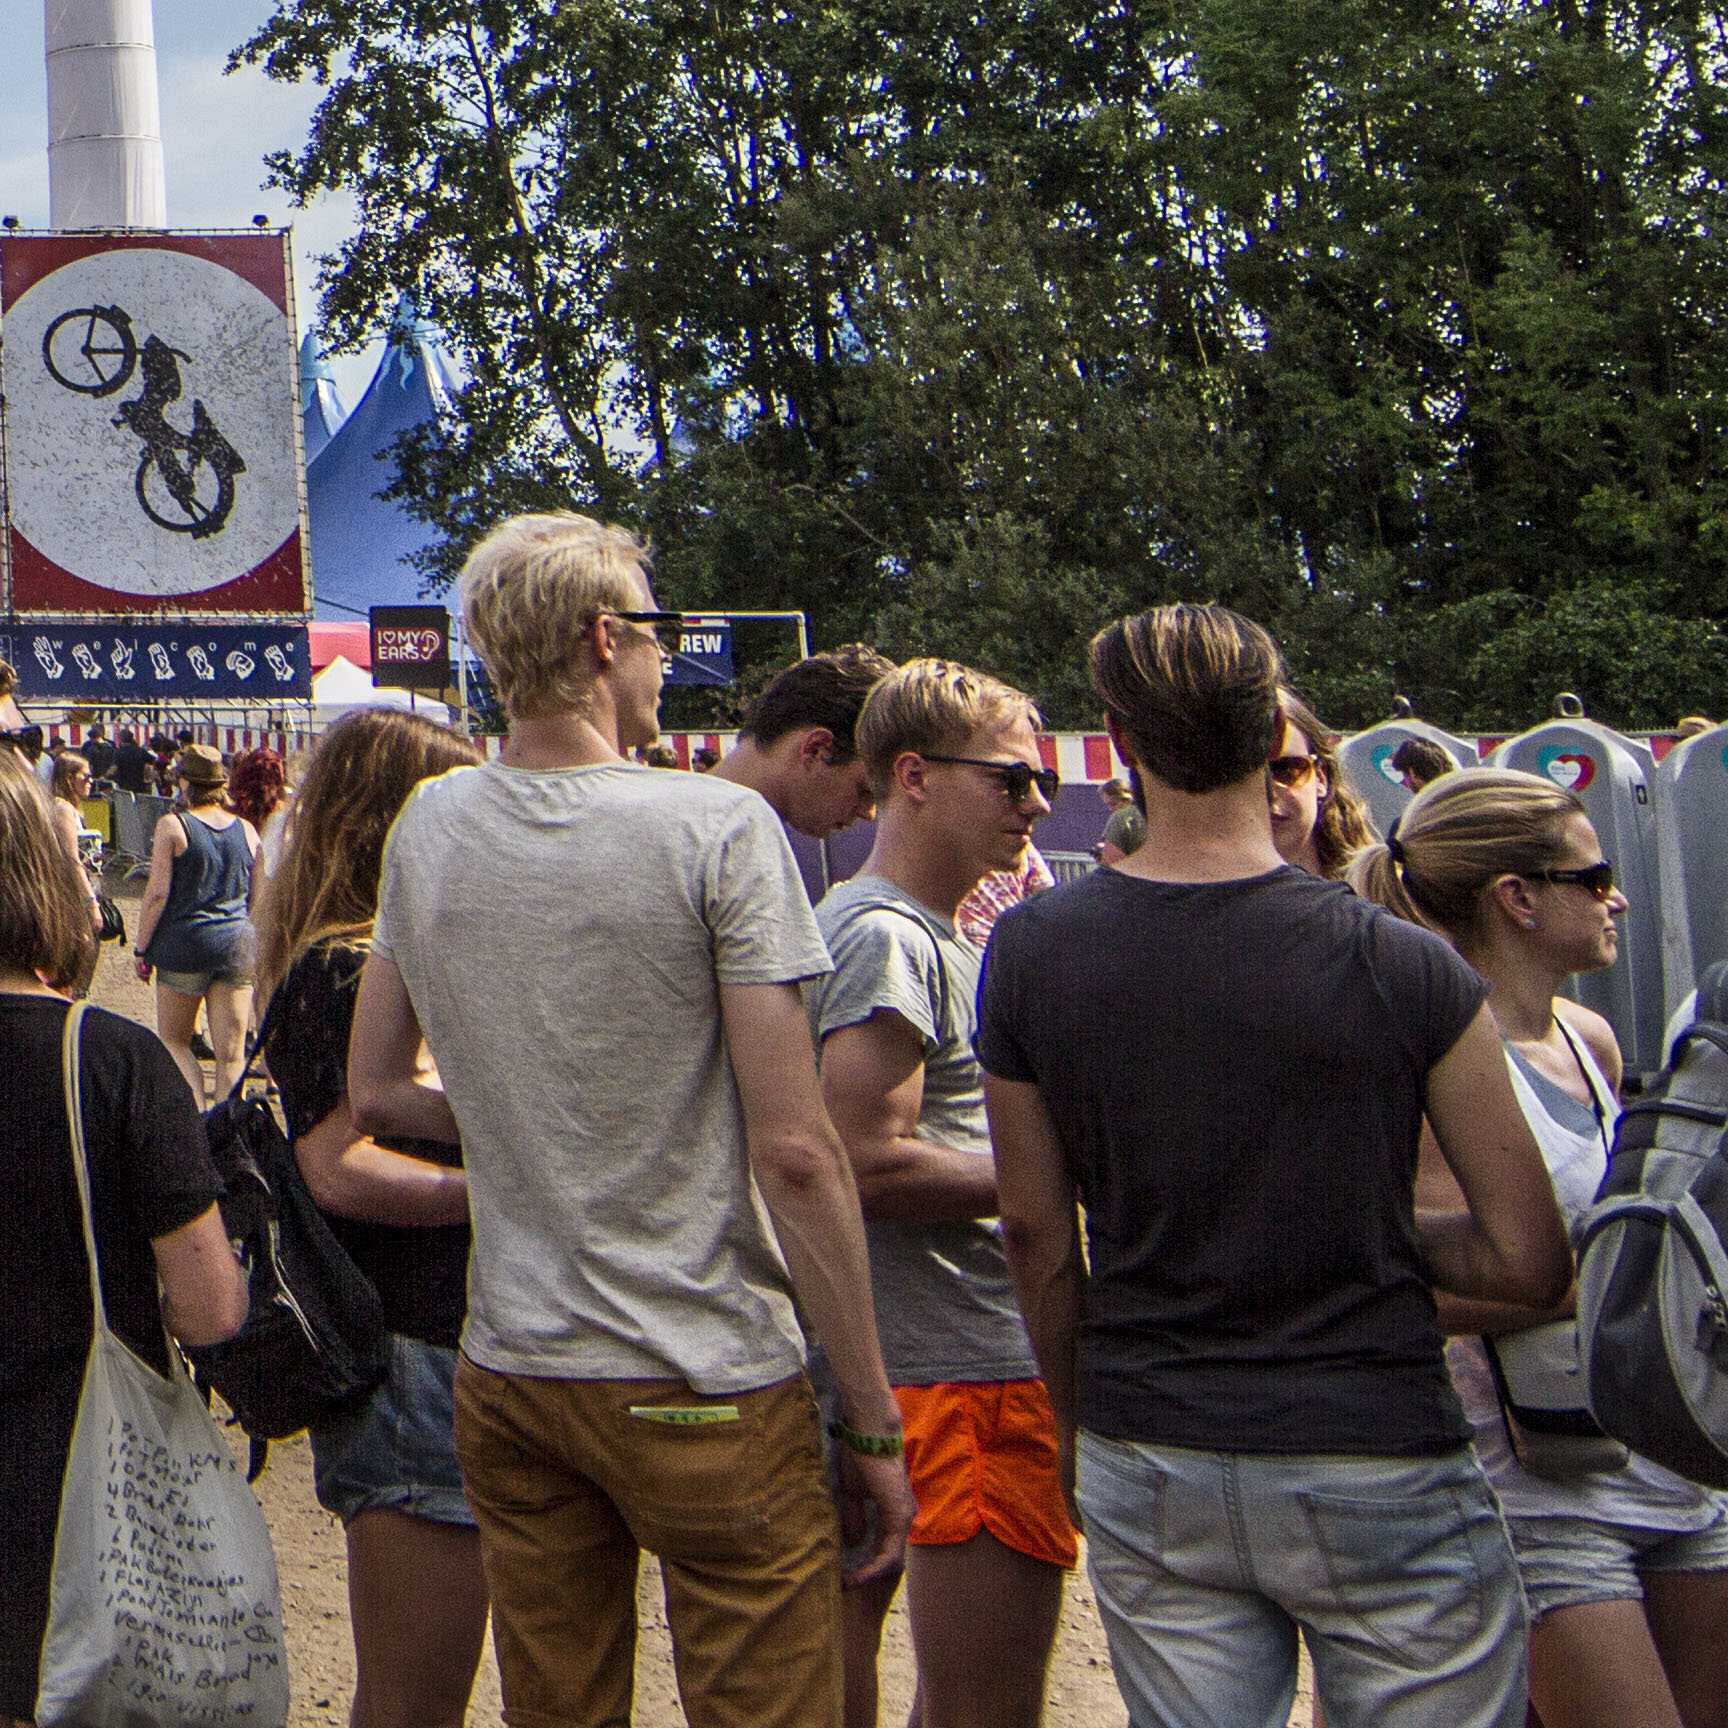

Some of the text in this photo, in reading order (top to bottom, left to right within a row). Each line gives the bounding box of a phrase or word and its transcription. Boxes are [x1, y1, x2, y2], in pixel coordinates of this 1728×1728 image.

[397, 631, 421, 644] MY
[679, 634, 722, 654] REW
[378, 646, 420, 660] EARS
